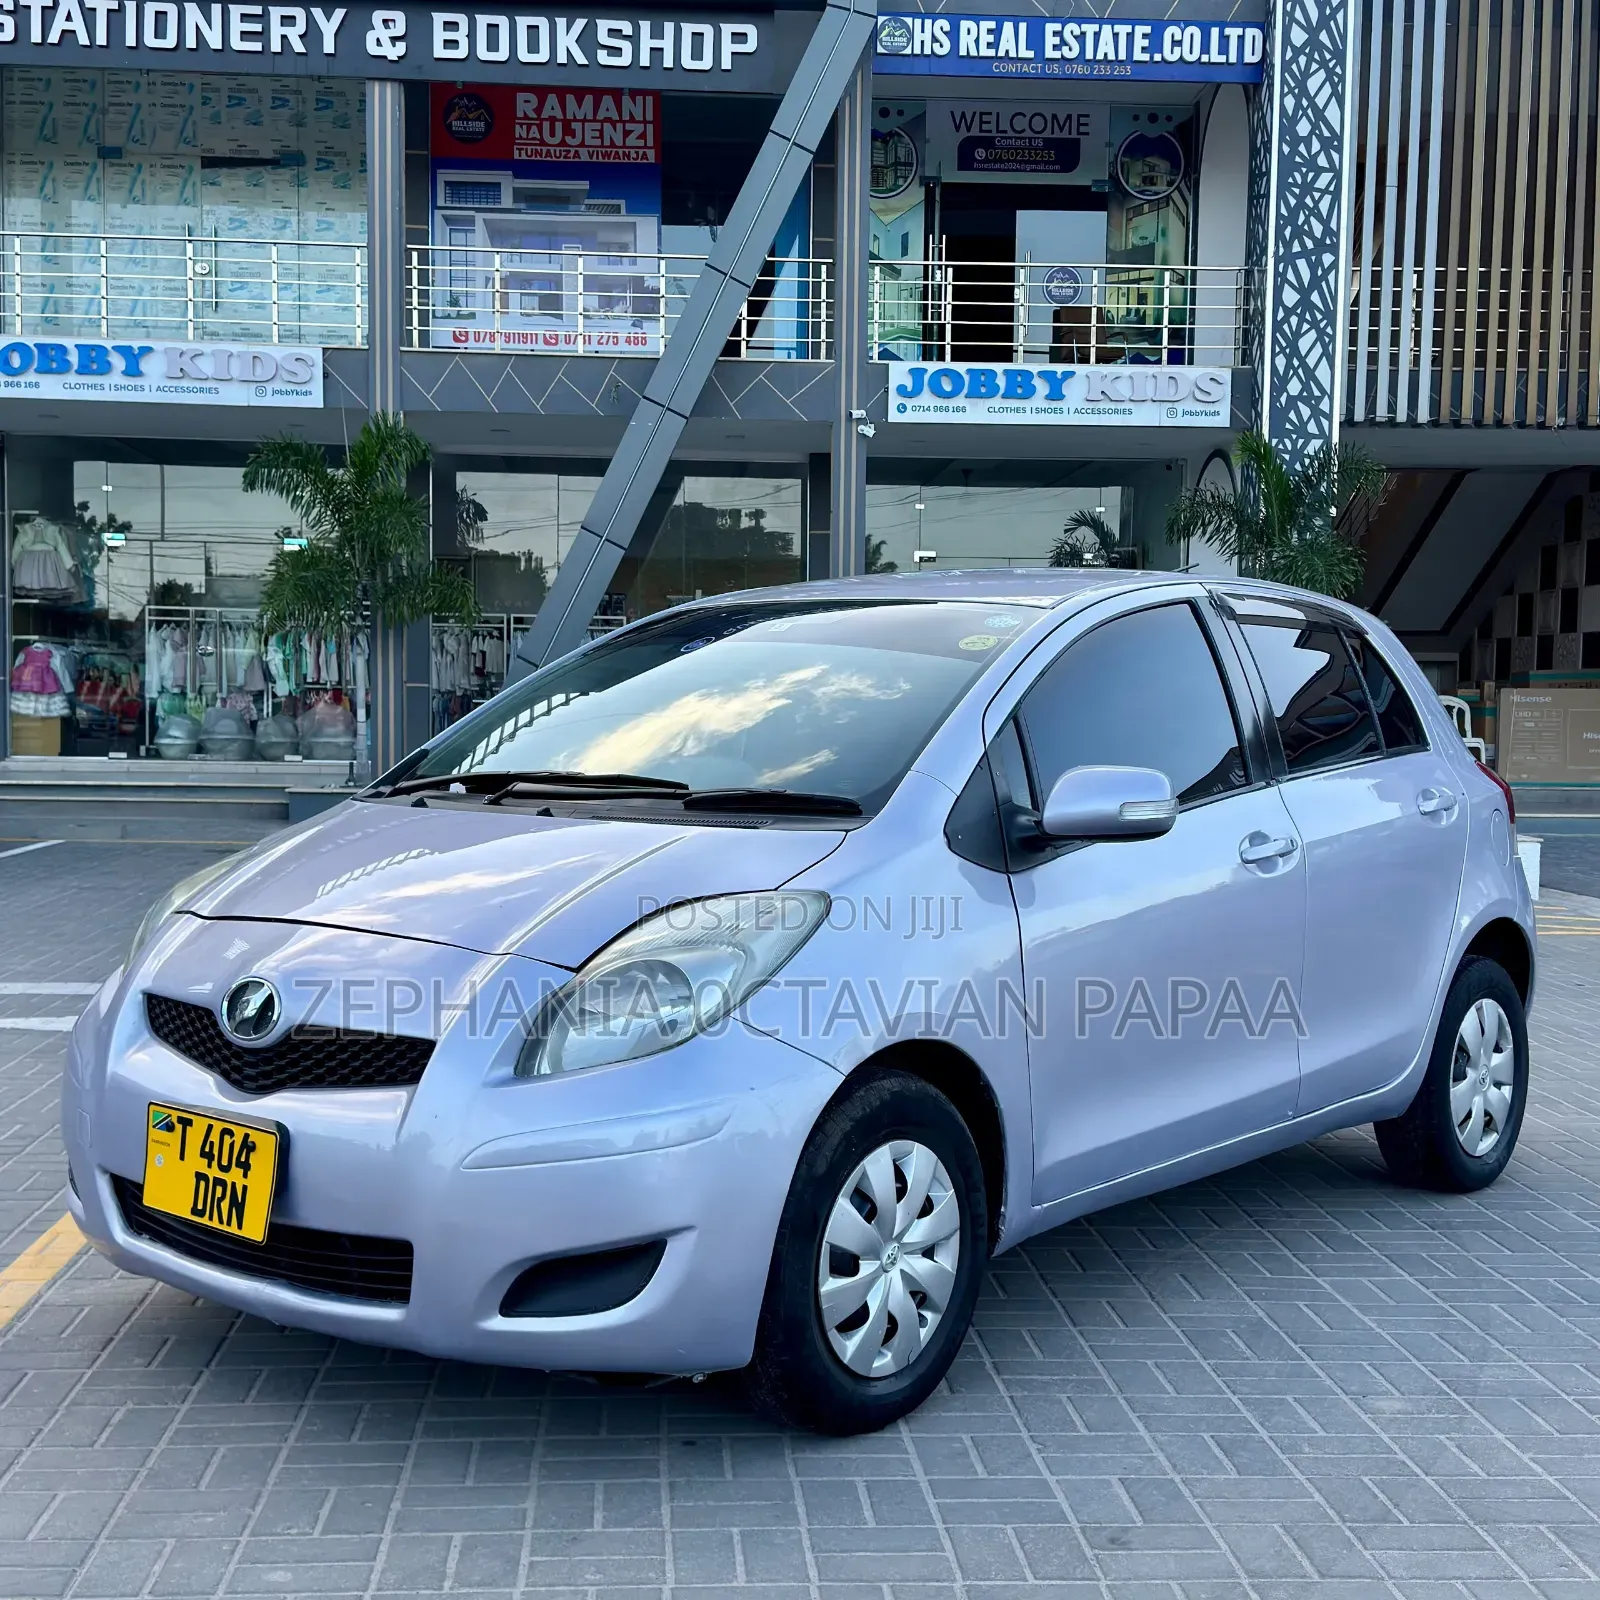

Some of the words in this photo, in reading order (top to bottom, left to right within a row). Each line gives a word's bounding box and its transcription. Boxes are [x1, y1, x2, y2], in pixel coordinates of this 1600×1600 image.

[366, 10, 407, 60] &
[431, 12, 758, 71] BOOKSHOP
[913, 18, 951, 56] HS
[959, 20, 1035, 60] REAL
[992, 62, 1042, 74] CONTACT
[1065, 64, 1090, 75] 0760
[1092, 64, 1112, 75] 233
[1114, 65, 1132, 76] 253
[516, 92, 653, 121] RAMANI
[514, 124, 540, 140] NA
[543, 121, 653, 147] UJENZI
[950, 110, 1090, 136] WELCOME
[516, 147, 582, 160] TUNAUZA
[586, 149, 650, 162] VIWANJA
[988, 149, 1056, 160] 0760233253
[995, 138, 1030, 146] Contact
[1032, 138, 1044, 146] US
[164, 347, 314, 385] KIDS
[62, 382, 104, 391] CLOTHES
[114, 384, 145, 392] SHOES
[156, 385, 220, 395] ACCESSORIES
[896, 368, 1076, 401] JOBBY
[1085, 370, 1226, 404] KIDS
[952, 406, 967, 414] 166
[987, 406, 1026, 414] CLOTHES
[1035, 407, 1064, 415] SHOES
[1073, 407, 1133, 416] ACCESSORIES
[176, 1116, 194, 1162] T
[200, 1123, 252, 1179] 404
[190, 1170, 248, 1230] DRN
